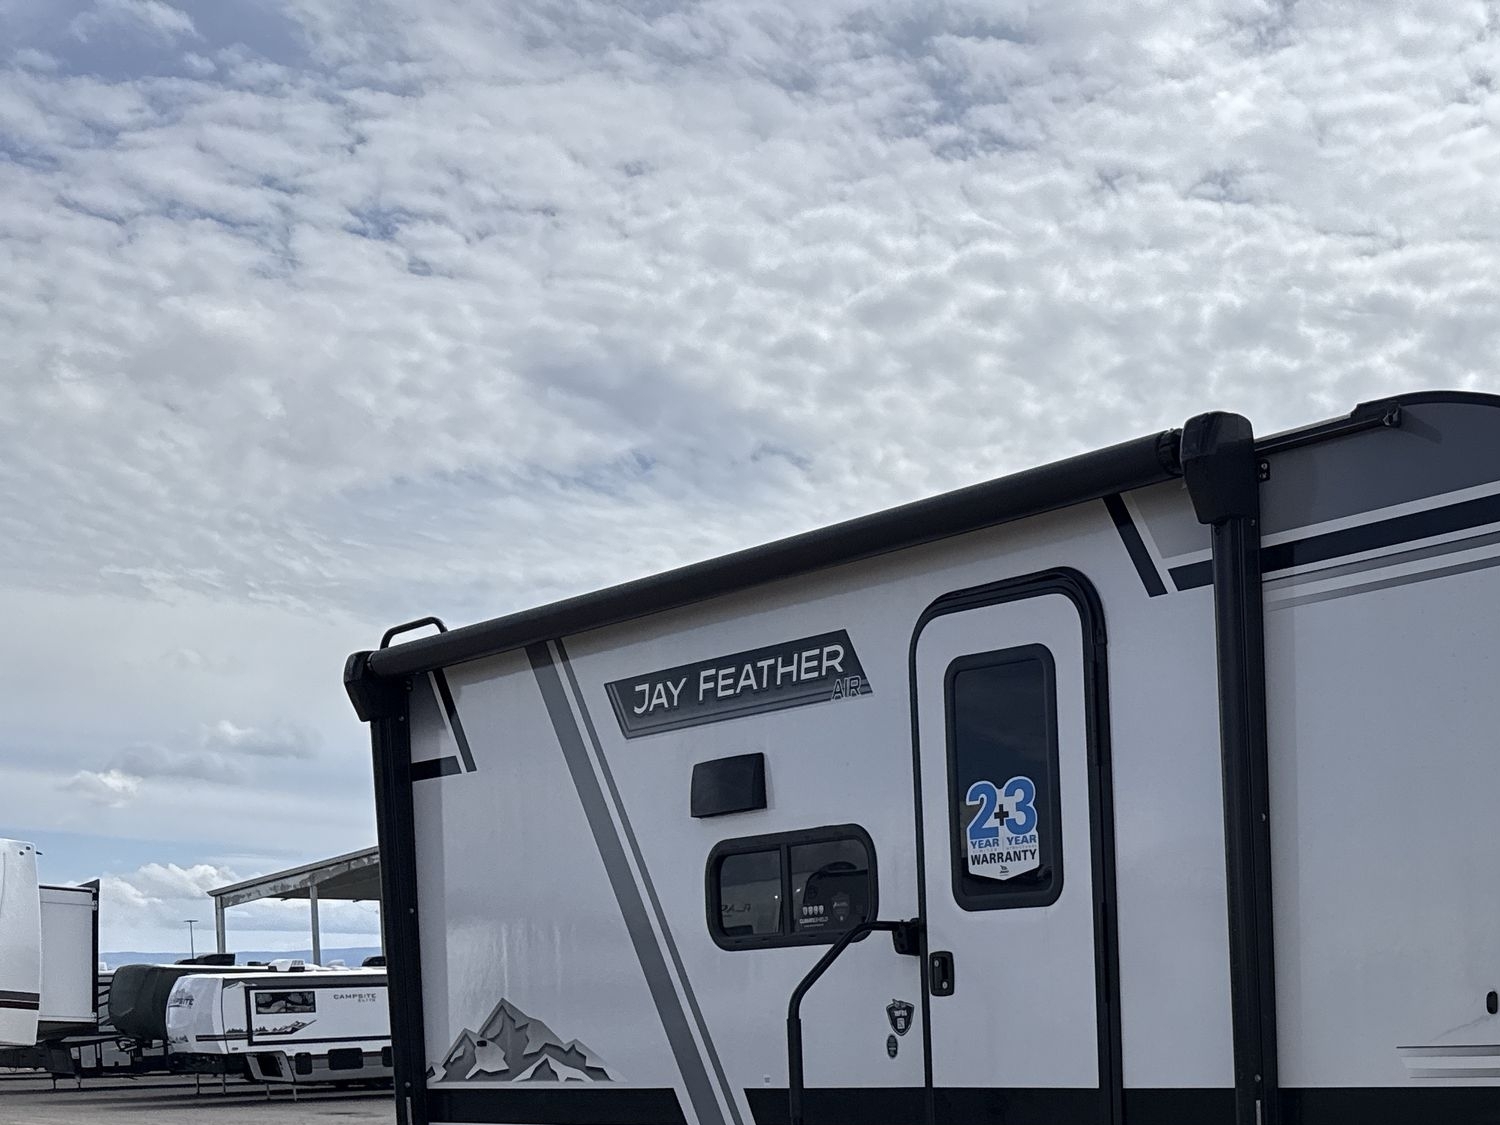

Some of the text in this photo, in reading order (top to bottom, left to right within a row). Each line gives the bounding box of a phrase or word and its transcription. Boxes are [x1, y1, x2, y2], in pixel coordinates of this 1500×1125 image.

[633, 644, 845, 714] JAY FEATHER
[831, 675, 862, 702] AIR
[970, 834, 1037, 849] YEAR YEAR
[970, 849, 1037, 866] WARRANTY
